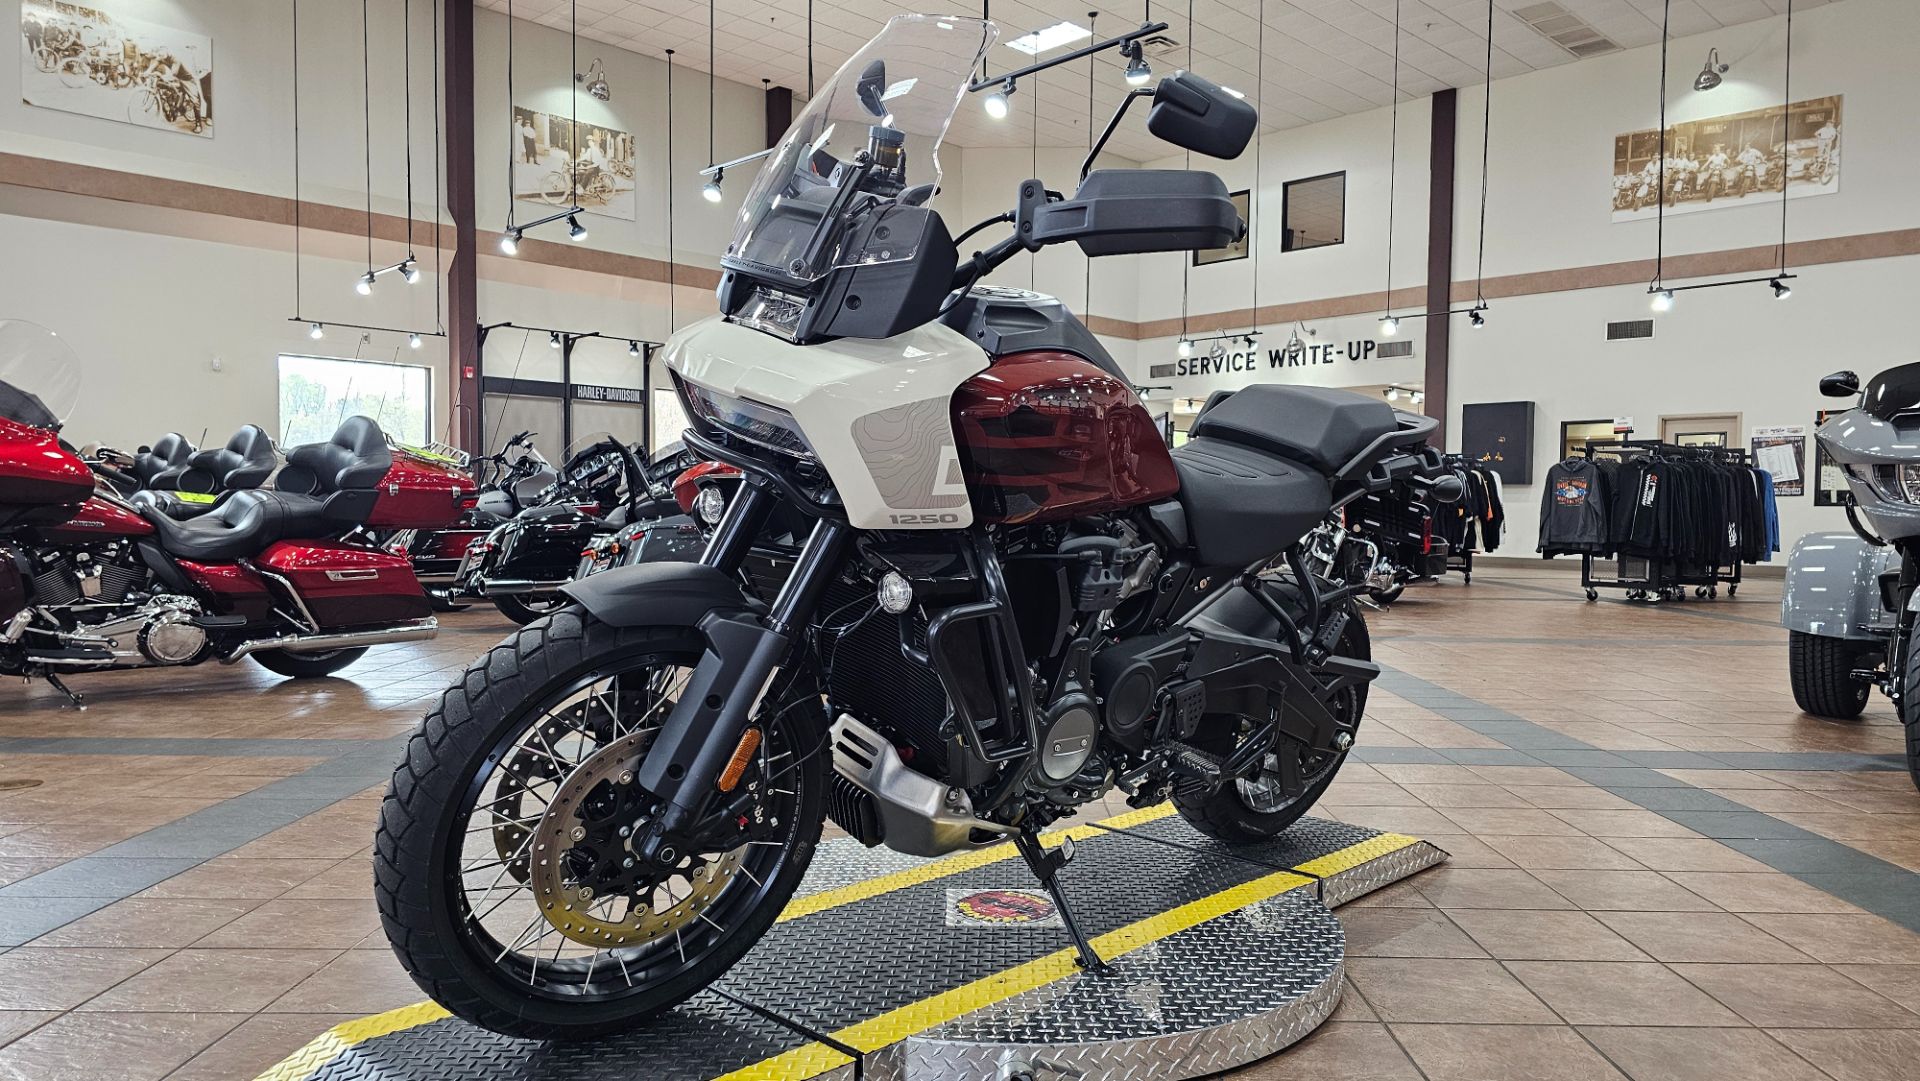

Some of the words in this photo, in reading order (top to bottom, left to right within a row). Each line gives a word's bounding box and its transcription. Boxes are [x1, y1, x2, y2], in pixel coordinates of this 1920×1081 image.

[1177, 352, 1256, 376] SERVICE
[1269, 340, 1376, 368] WRITE-UP
[577, 385, 640, 402] HARLEY-DAVIDSON
[889, 513, 958, 524] 1250
